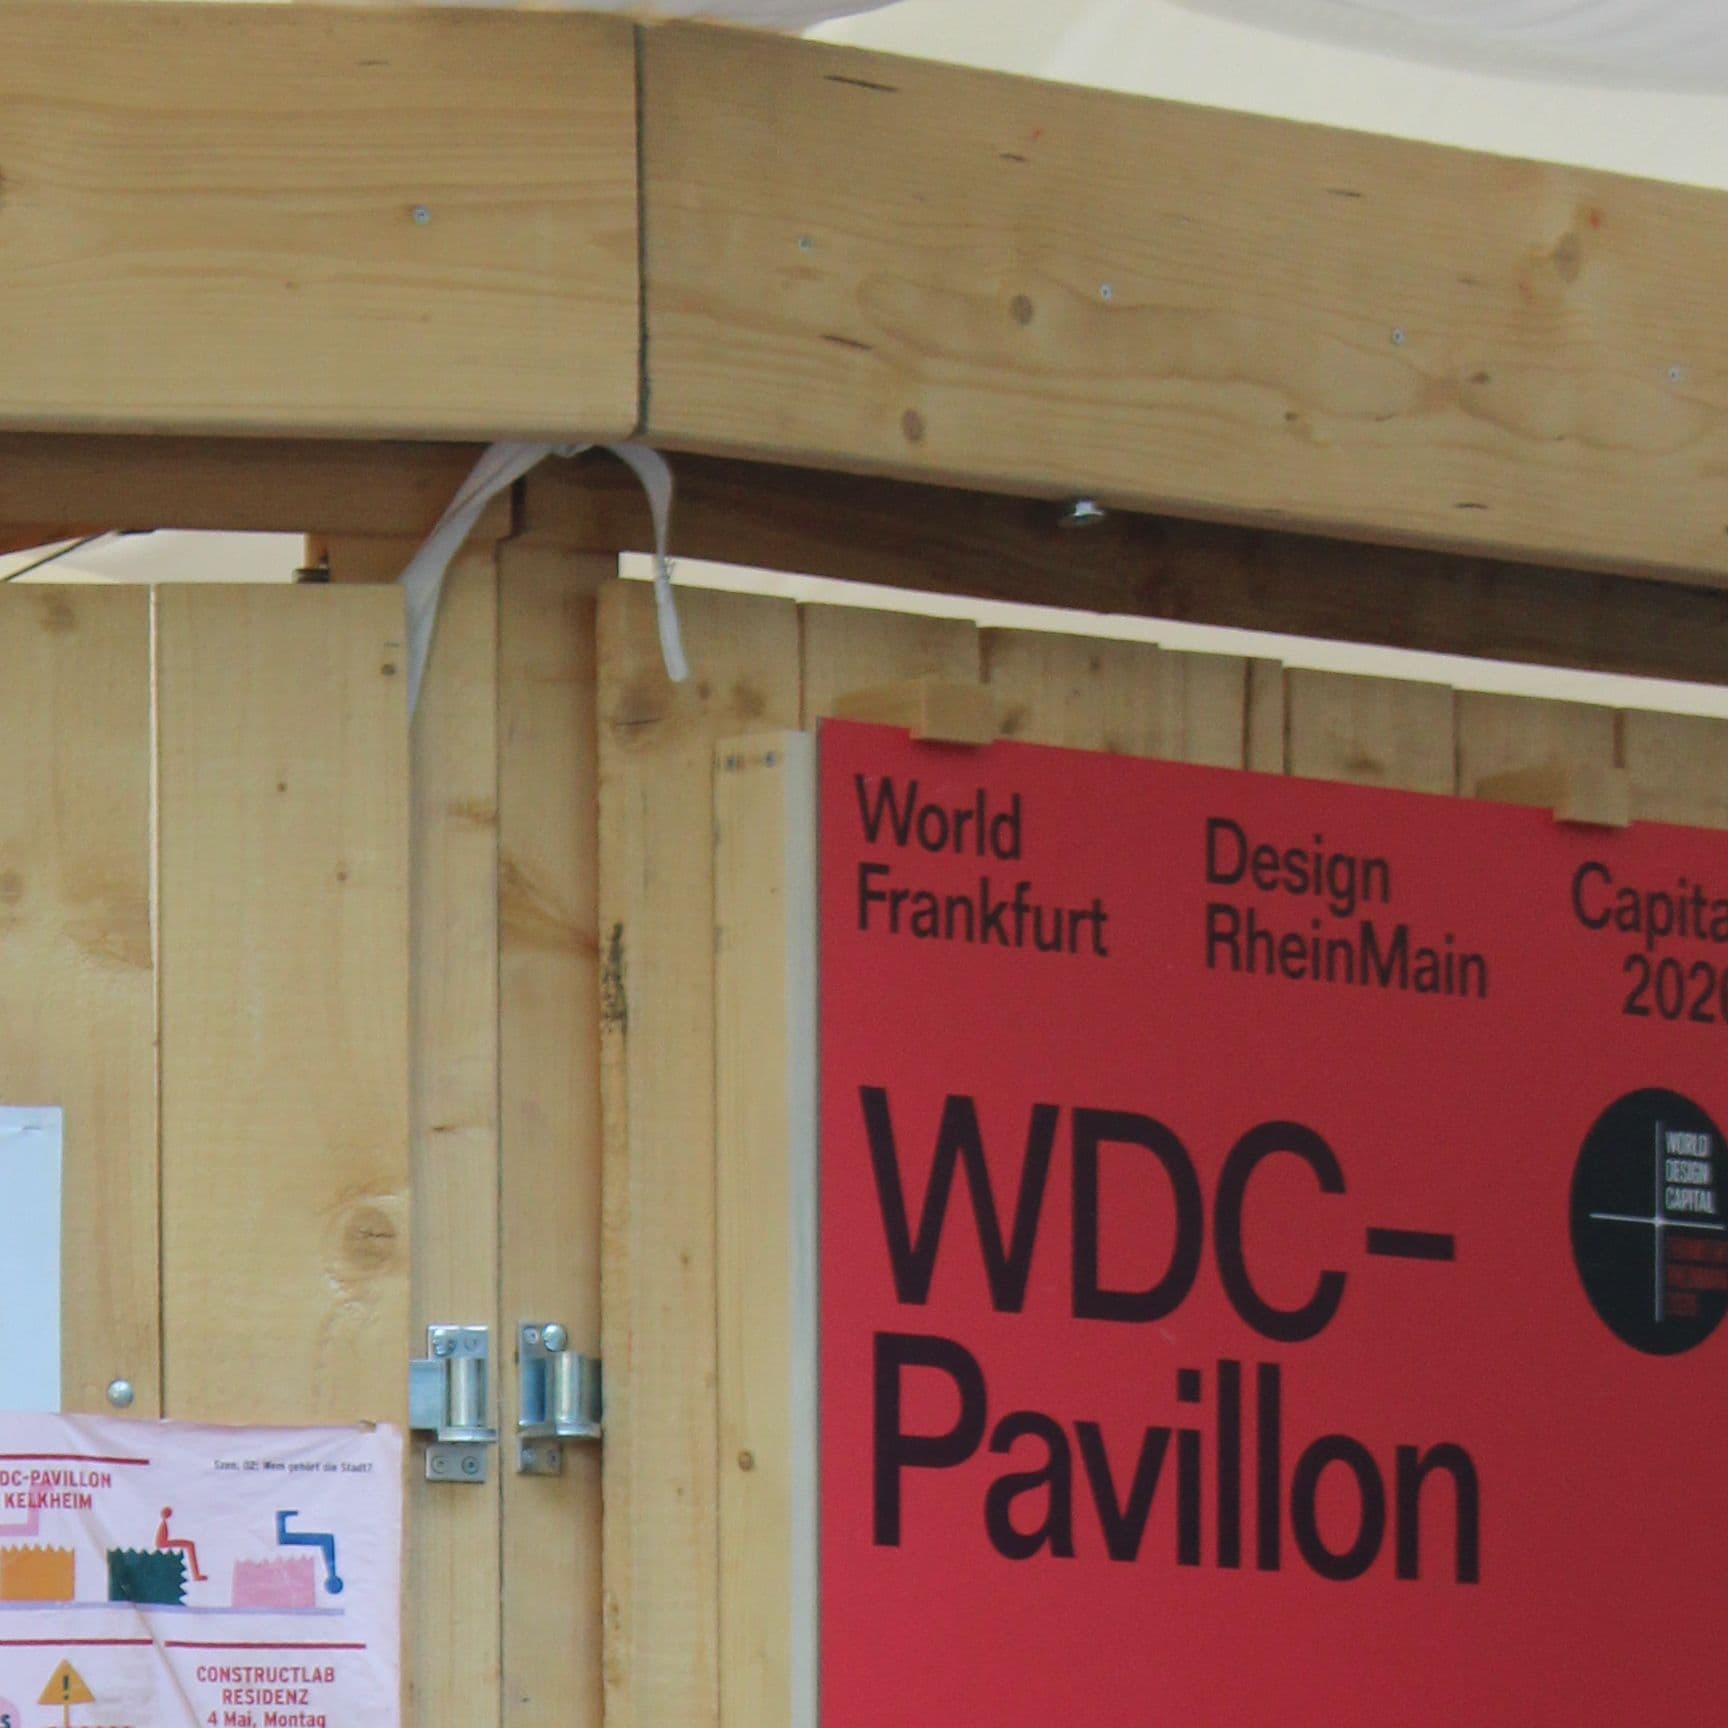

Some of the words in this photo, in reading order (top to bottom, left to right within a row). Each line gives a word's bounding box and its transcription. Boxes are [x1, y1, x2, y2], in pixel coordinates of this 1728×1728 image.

[854, 774, 1022, 860] World
[1205, 817, 1390, 918] Design
[857, 862, 1108, 957] Frankfurt
[1205, 903, 1487, 998] RheinMain
[1624, 953, 1728, 1024] 202
[1665, 1187, 1715, 1214] CAPITAL
[872, 1331, 1480, 1586] Pavillon
[4, 1493, 93, 1509] KELKHEIM
[197, 1666, 335, 1683] CONSTRUCTLAB
[222, 1688, 309, 1705] RESIDENZ
[207, 1710, 217, 1727] 4
[223, 1711, 256, 1728] Mai,
